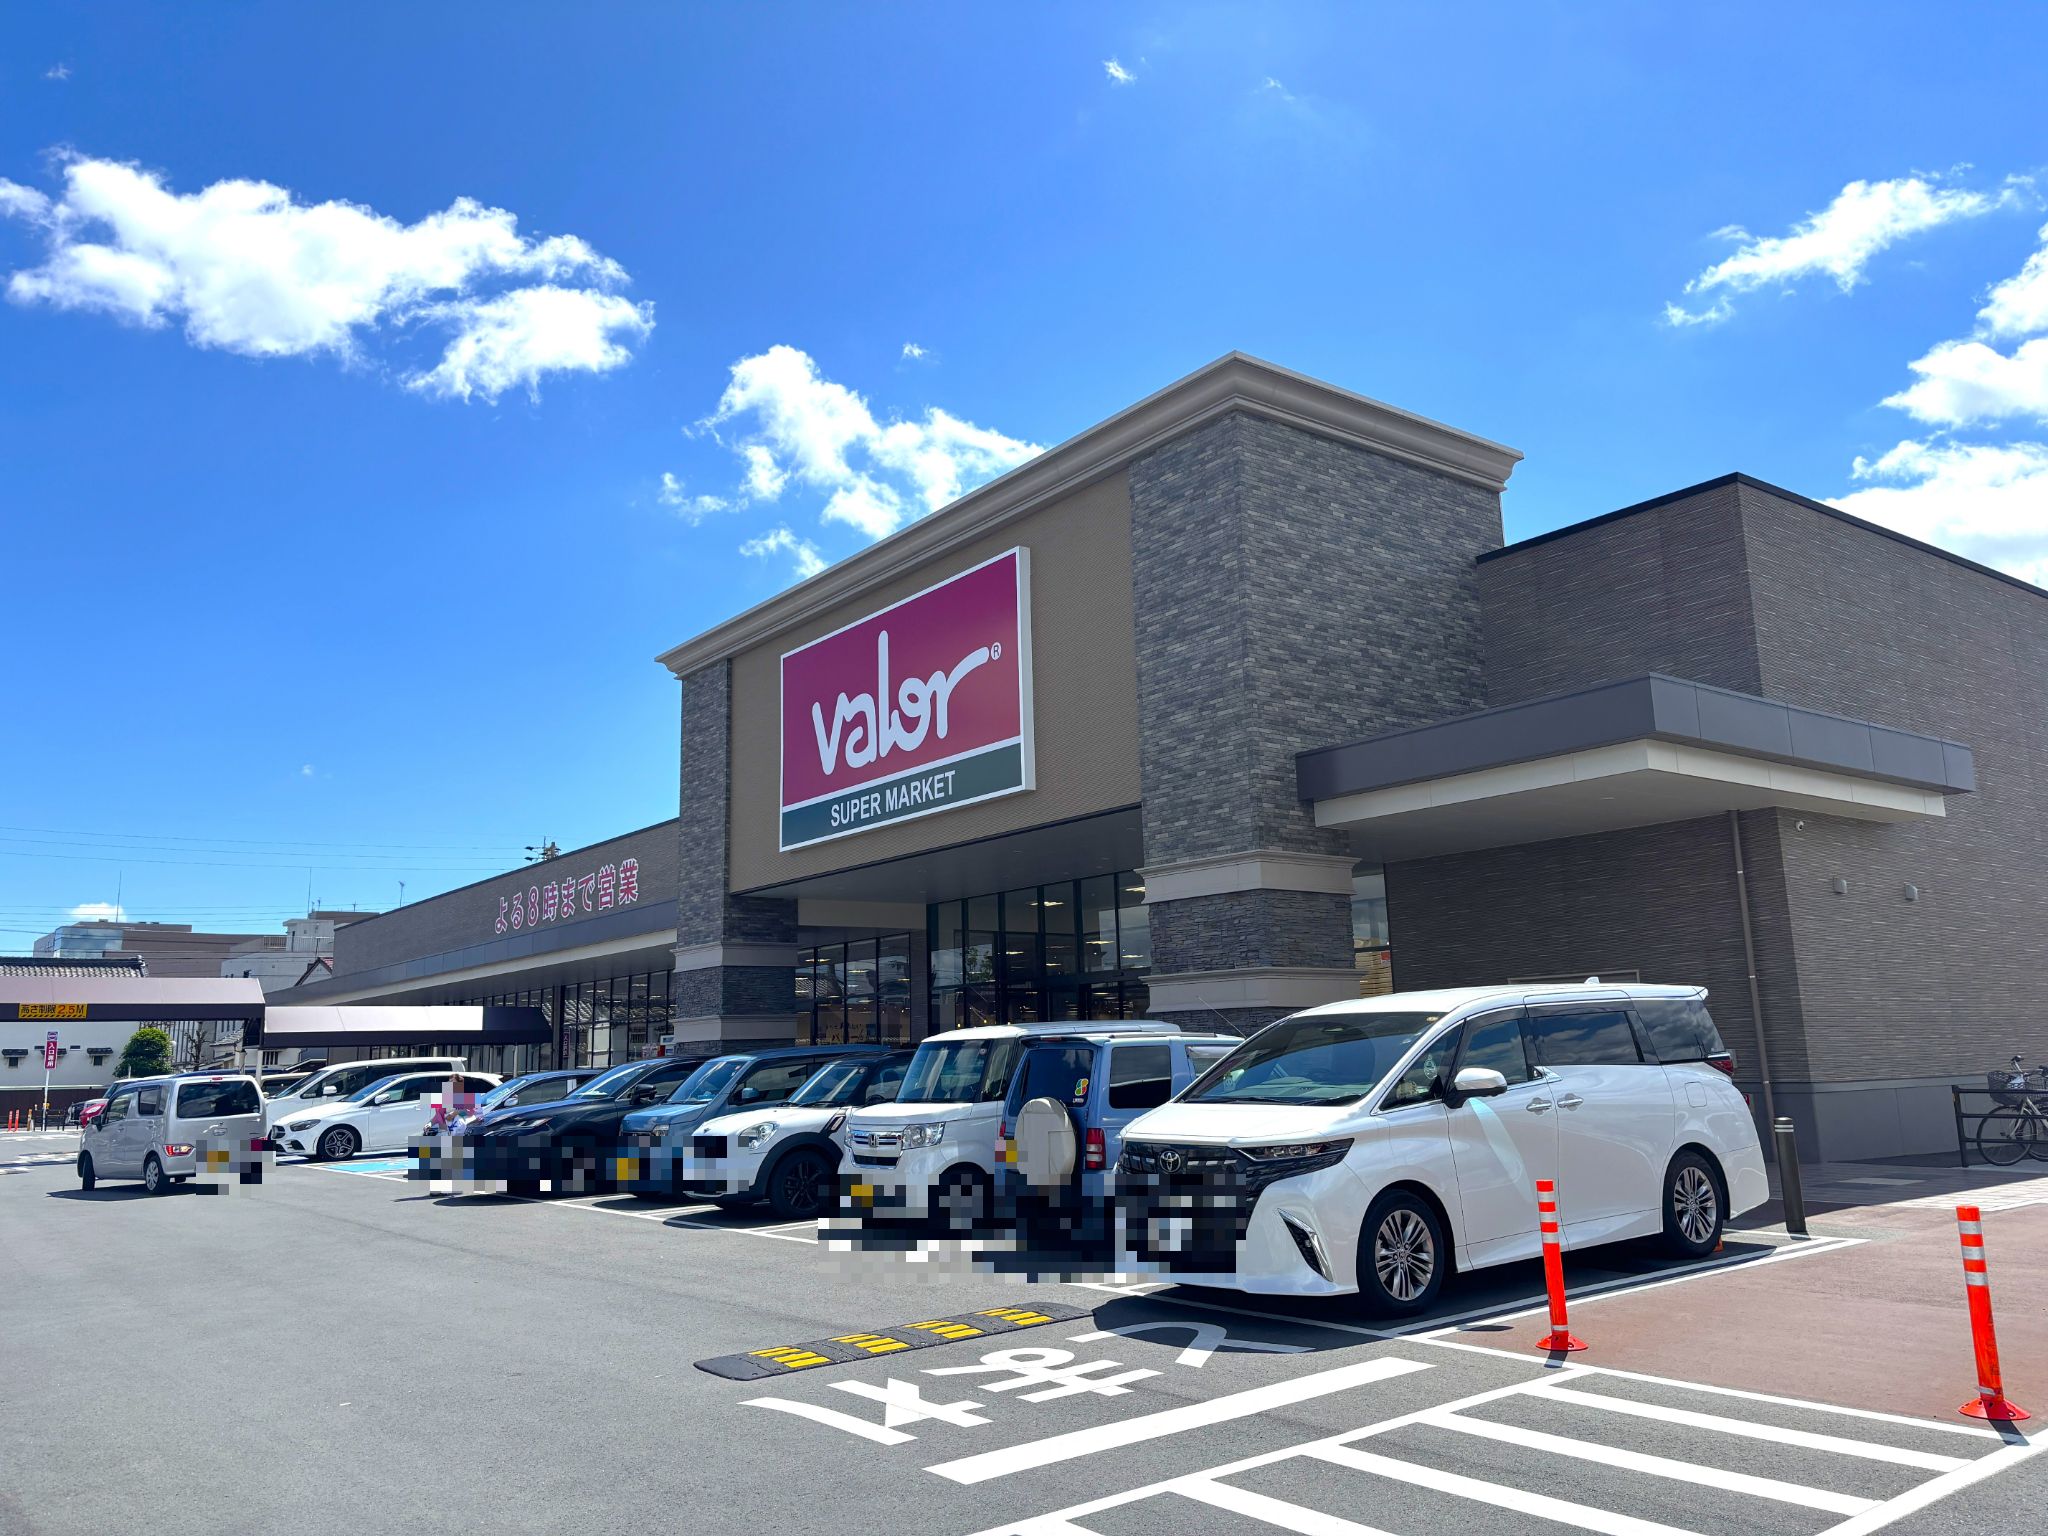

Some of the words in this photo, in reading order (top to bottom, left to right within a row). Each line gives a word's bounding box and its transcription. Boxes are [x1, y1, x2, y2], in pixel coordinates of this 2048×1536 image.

[811, 630, 989, 776] valor
[830, 792, 882, 827] SUPER
[885, 769, 956, 813] MARKET
[494, 857, 639, 934] よる8時まで営業
